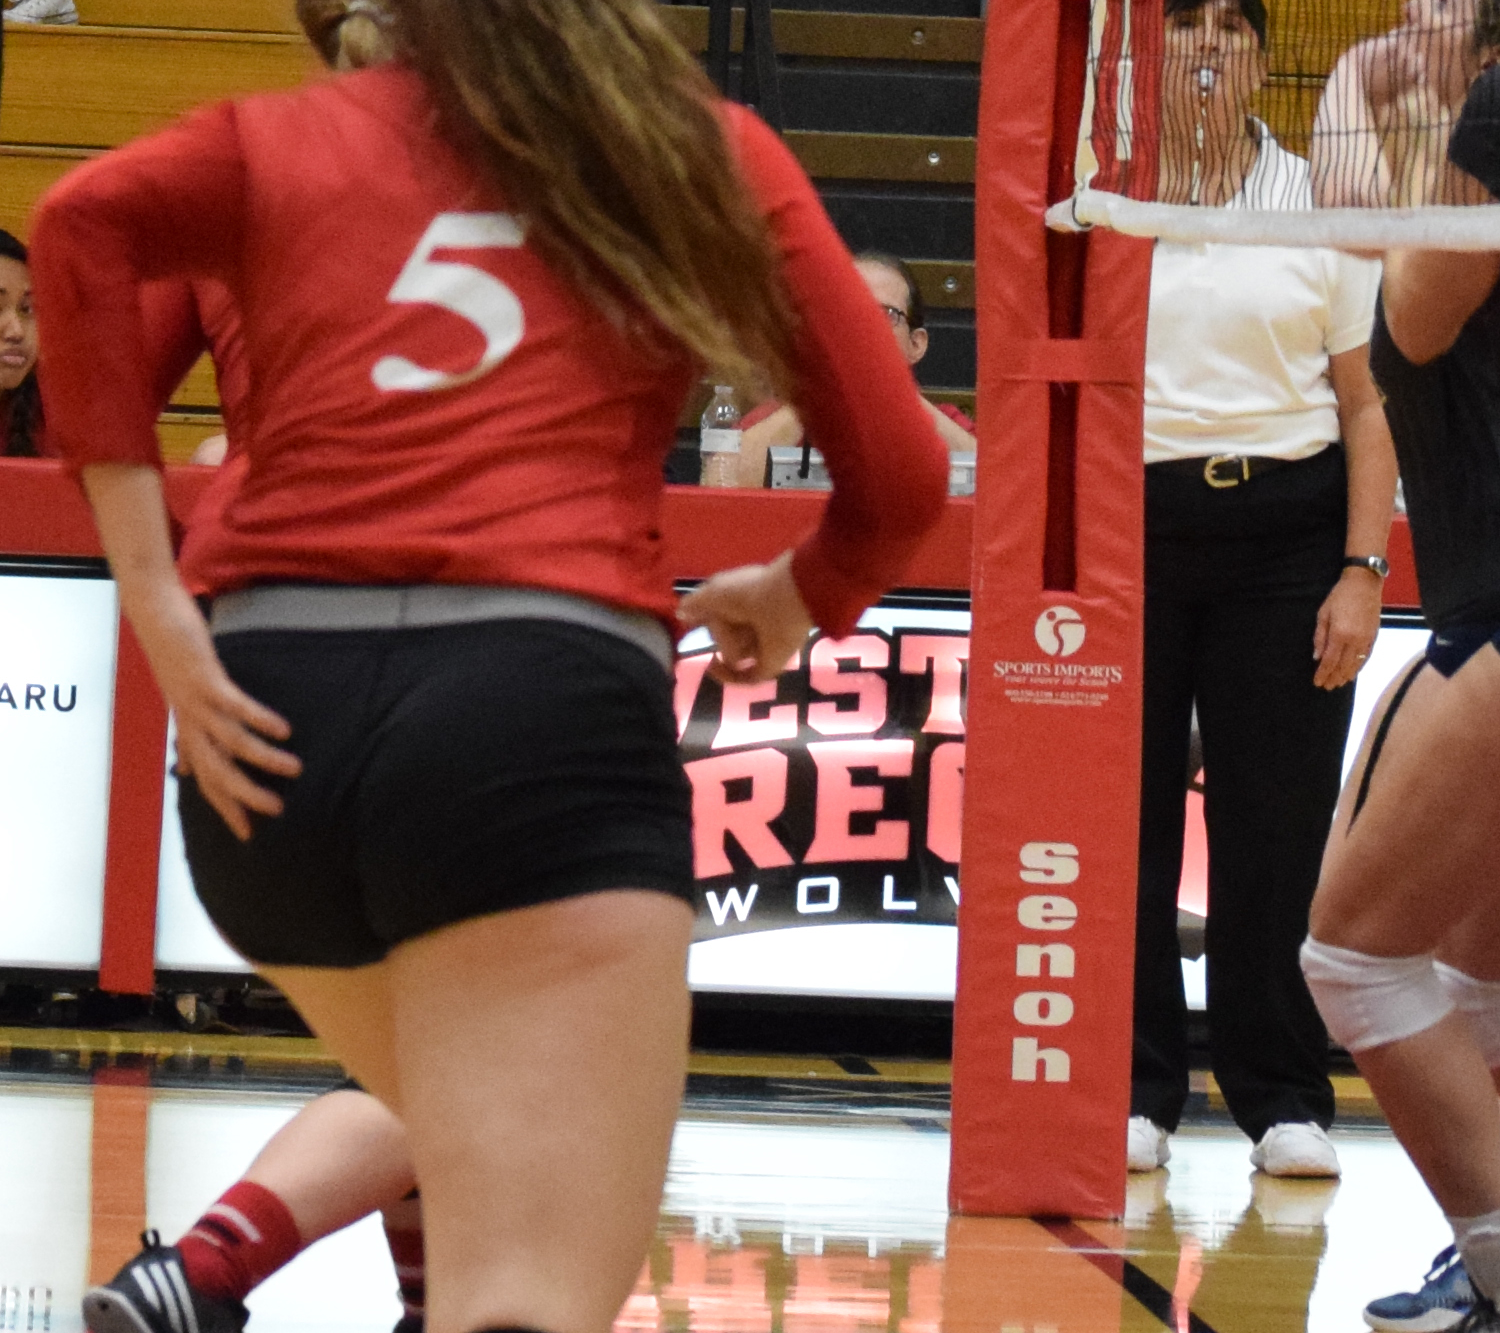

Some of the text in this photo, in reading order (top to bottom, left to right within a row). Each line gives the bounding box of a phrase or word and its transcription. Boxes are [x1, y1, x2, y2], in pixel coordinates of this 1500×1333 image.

[371, 211, 526, 391] 5
[993, 661, 1051, 678] SPORTS
[1054, 662, 1122, 683] IMPORTS
[1011, 841, 1079, 1083] senoh
